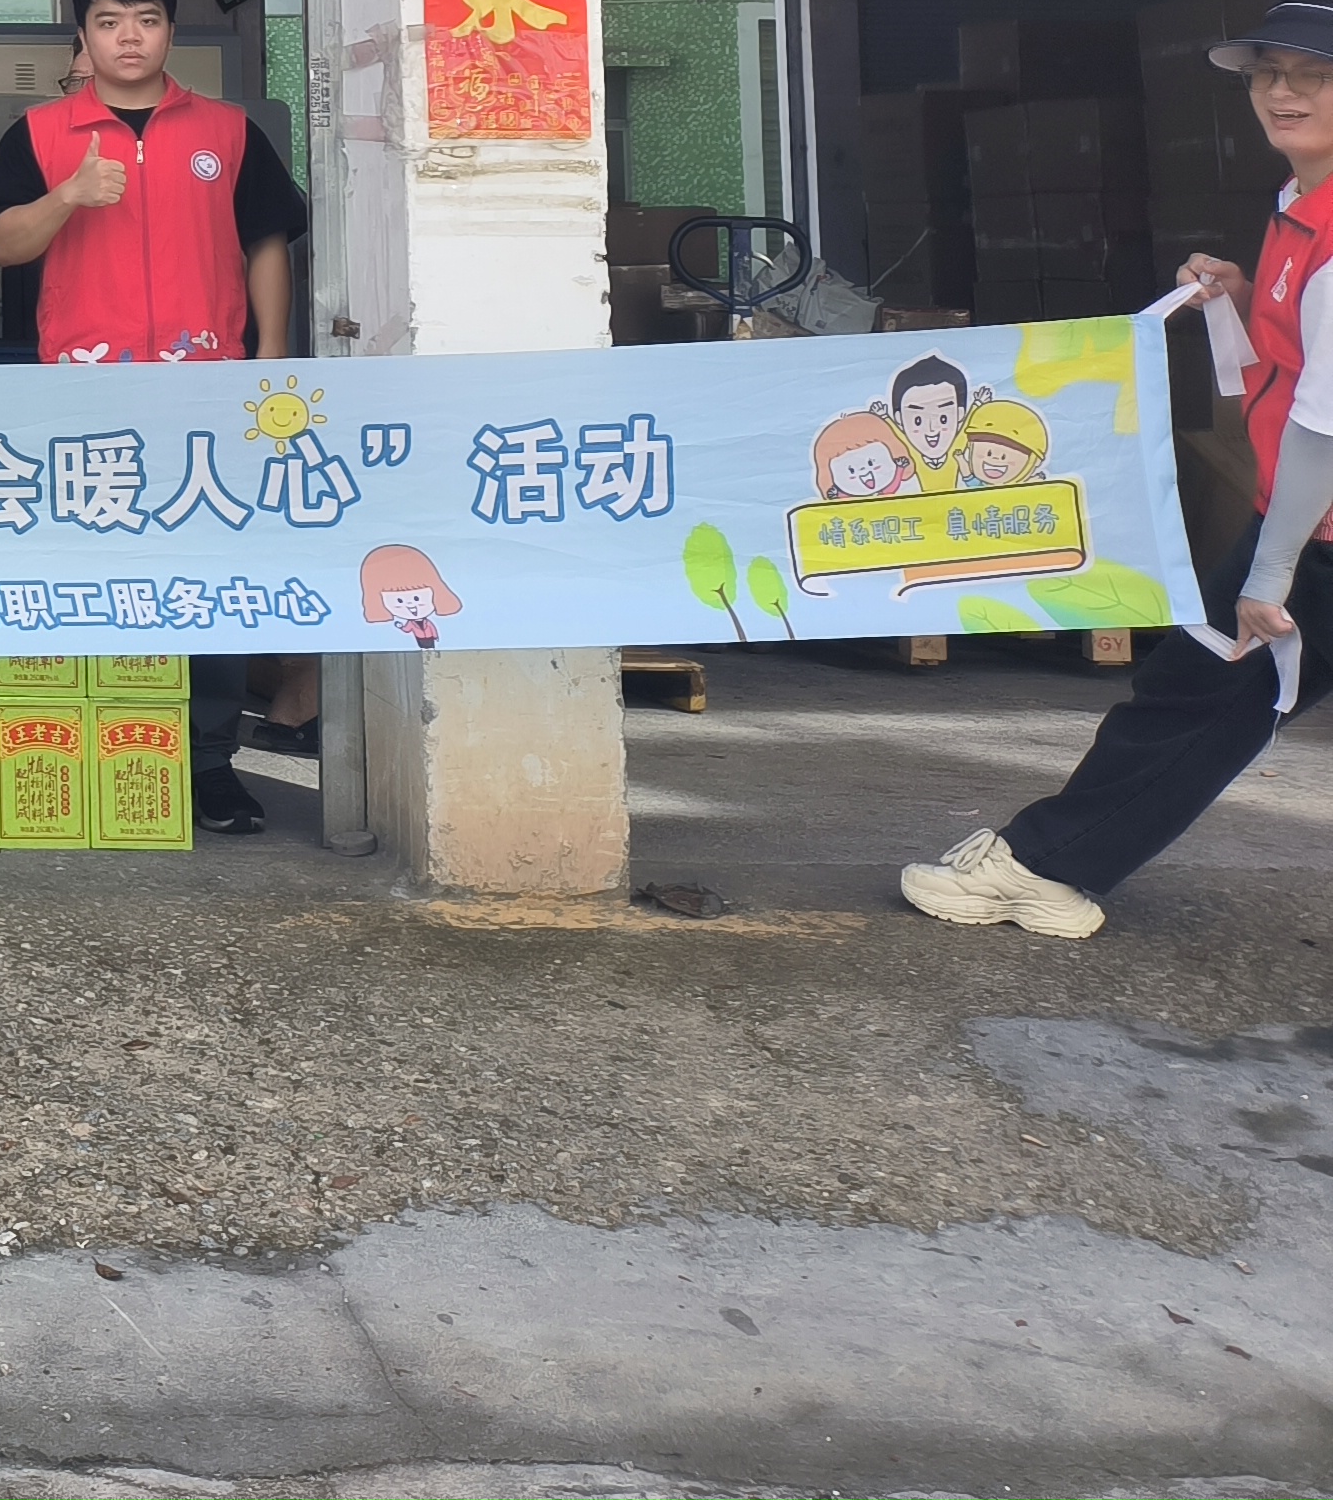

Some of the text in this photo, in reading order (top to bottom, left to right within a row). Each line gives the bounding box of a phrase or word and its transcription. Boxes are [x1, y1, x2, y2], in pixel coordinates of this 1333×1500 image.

[469, 414, 675, 524] 活动
[818, 503, 1060, 549] 情系职工 真情服务
[14, 723, 64, 744] 王老吉
[115, 724, 165, 745] 王老吉
